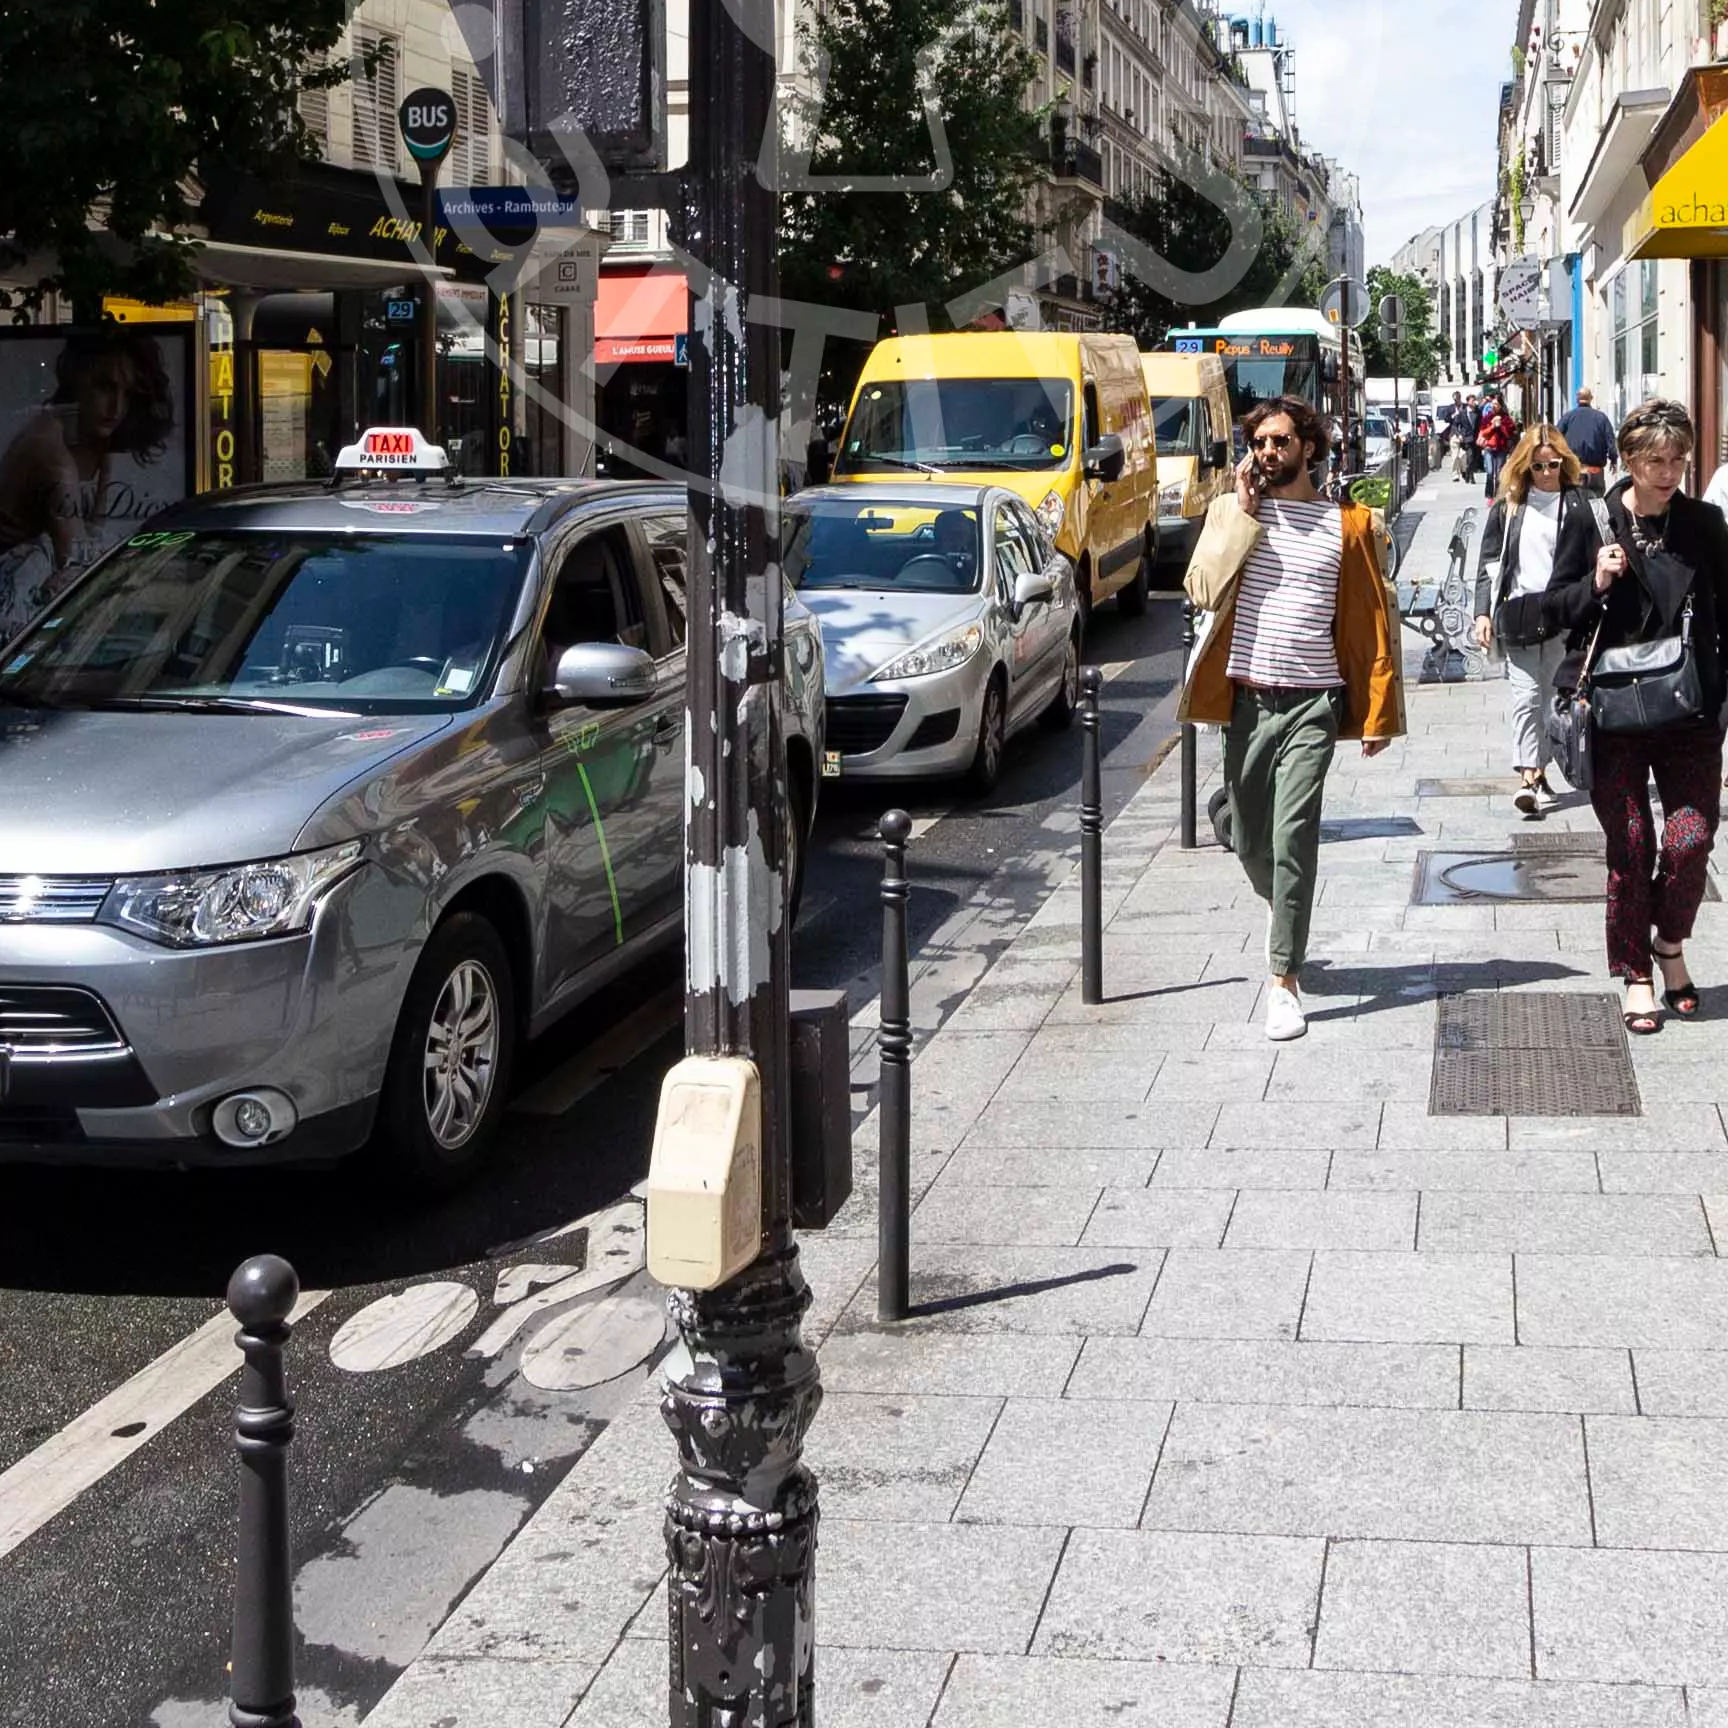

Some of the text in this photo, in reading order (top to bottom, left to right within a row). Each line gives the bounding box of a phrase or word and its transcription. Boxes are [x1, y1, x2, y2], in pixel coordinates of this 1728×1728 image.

[406, 104, 448, 129] BUS
[443, 201, 494, 215] Archives
[504, 200, 573, 215] Rambuteau
[368, 215, 422, 243] ACHAT
[391, 303, 411, 318] 29
[1179, 341, 1199, 354] 29
[1215, 339, 1251, 356] Picpus
[1260, 339, 1294, 356] Reuilly
[498, 291, 512, 477] ACHAT OR
[368, 433, 409, 453] TAXI
[359, 454, 417, 464] PARISIEN
